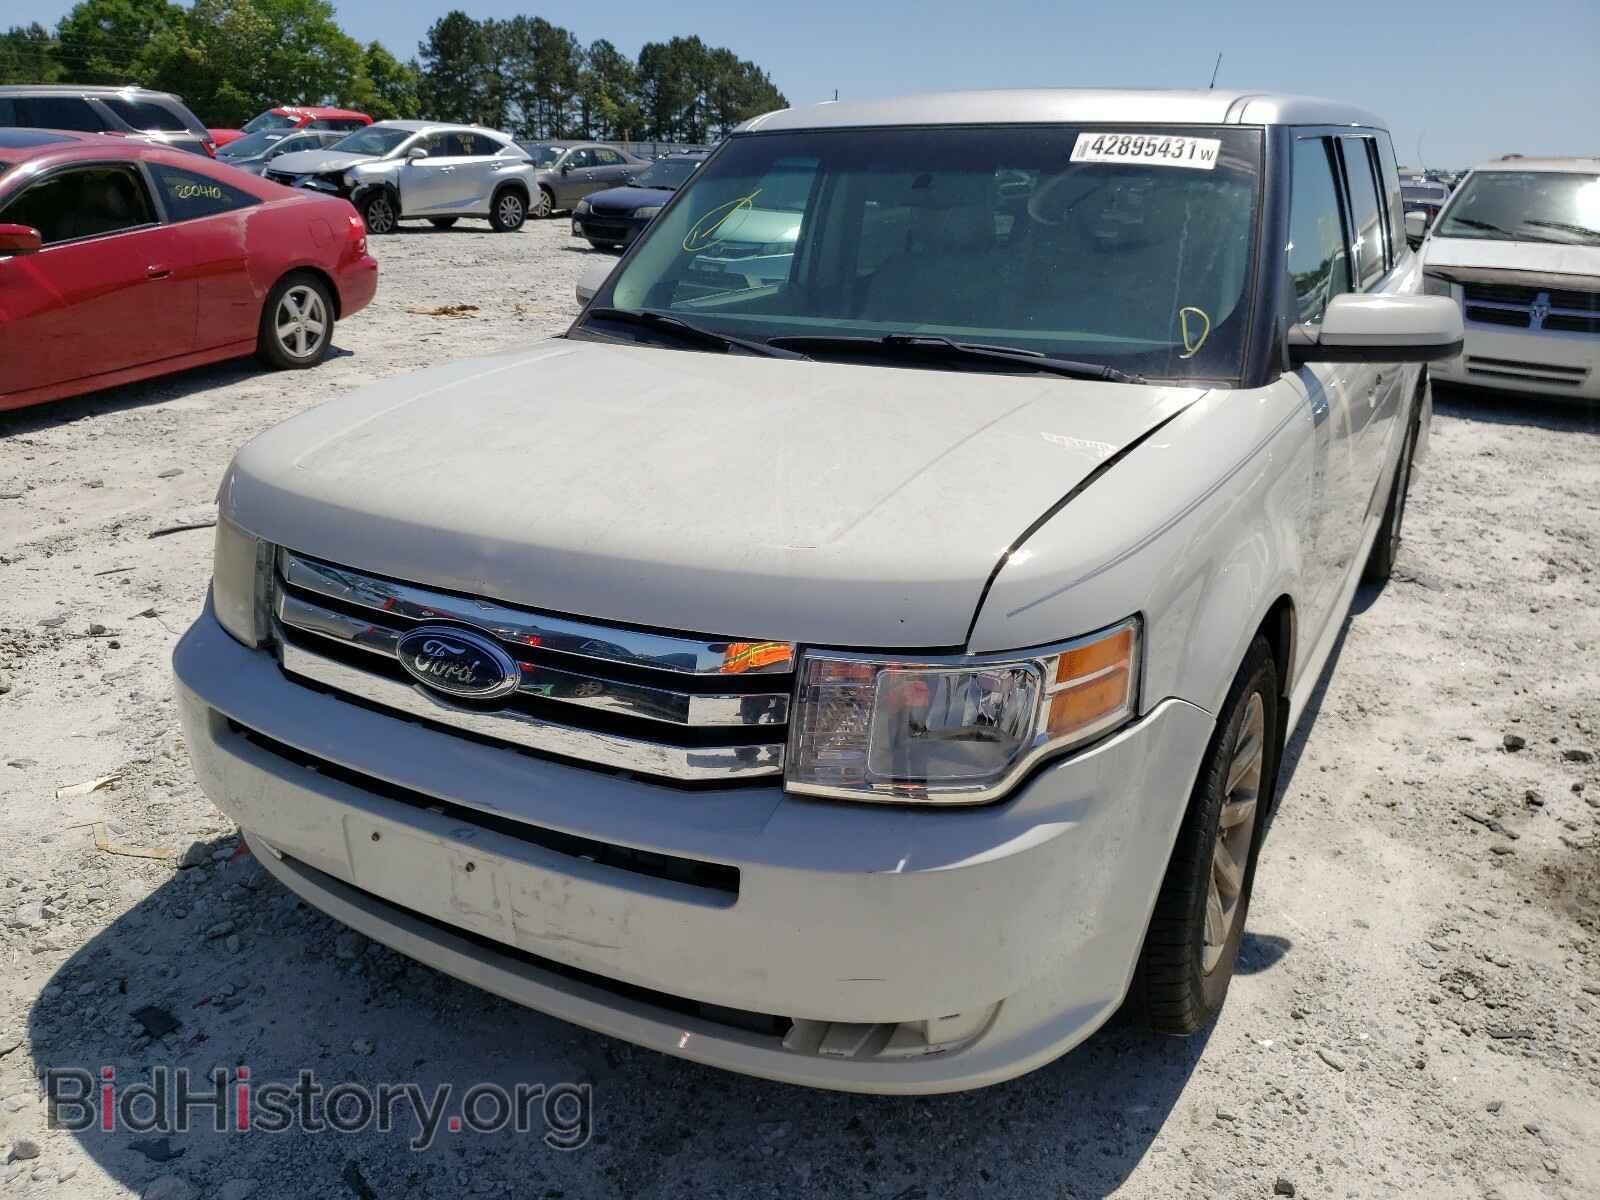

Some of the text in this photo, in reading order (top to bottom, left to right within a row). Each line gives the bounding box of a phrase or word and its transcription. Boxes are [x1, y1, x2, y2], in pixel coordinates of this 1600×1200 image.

[1091, 134, 1198, 160] 42895431
[1179, 306, 1210, 358] D
[414, 639, 481, 684] Ford
